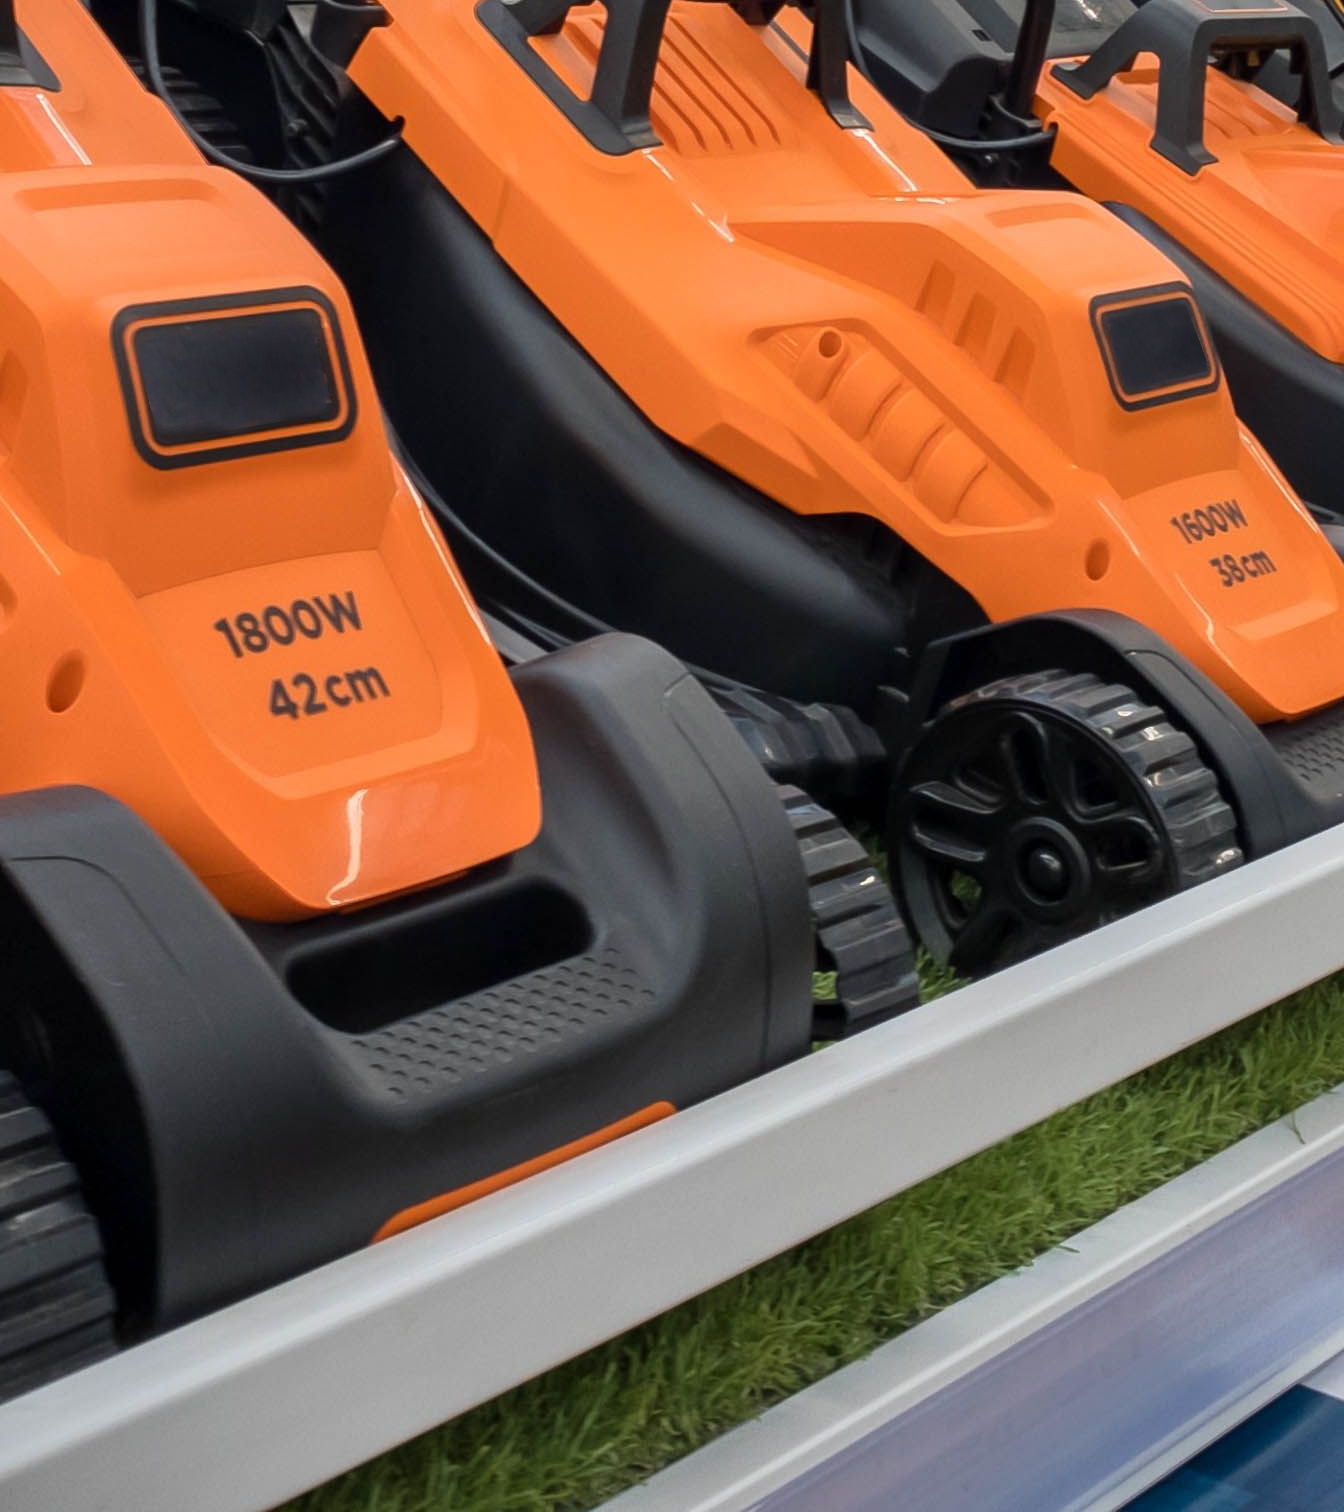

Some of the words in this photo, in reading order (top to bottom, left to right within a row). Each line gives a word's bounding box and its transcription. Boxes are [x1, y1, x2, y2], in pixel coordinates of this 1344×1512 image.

[1170, 499, 1248, 544] 1600W
[1209, 551, 1277, 587] 38cm
[214, 591, 362, 658] 1800W
[269, 667, 391, 720] 42cm
